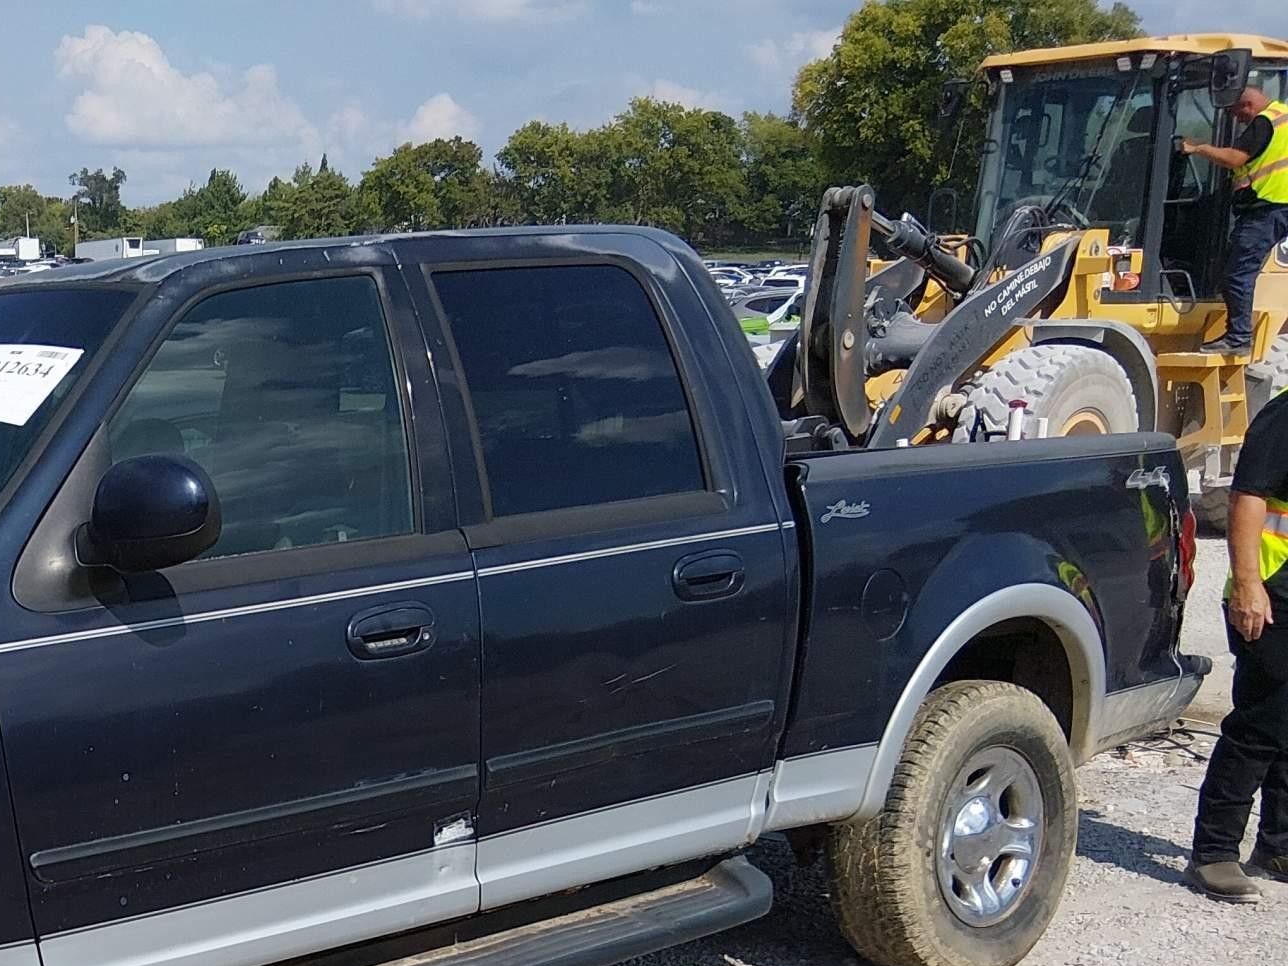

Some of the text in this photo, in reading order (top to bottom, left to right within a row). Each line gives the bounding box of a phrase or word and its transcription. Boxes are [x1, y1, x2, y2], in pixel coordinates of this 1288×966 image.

[984, 256, 1051, 317] NO CAMINE DEBAJO
[1001, 298, 1016, 316] DEL
